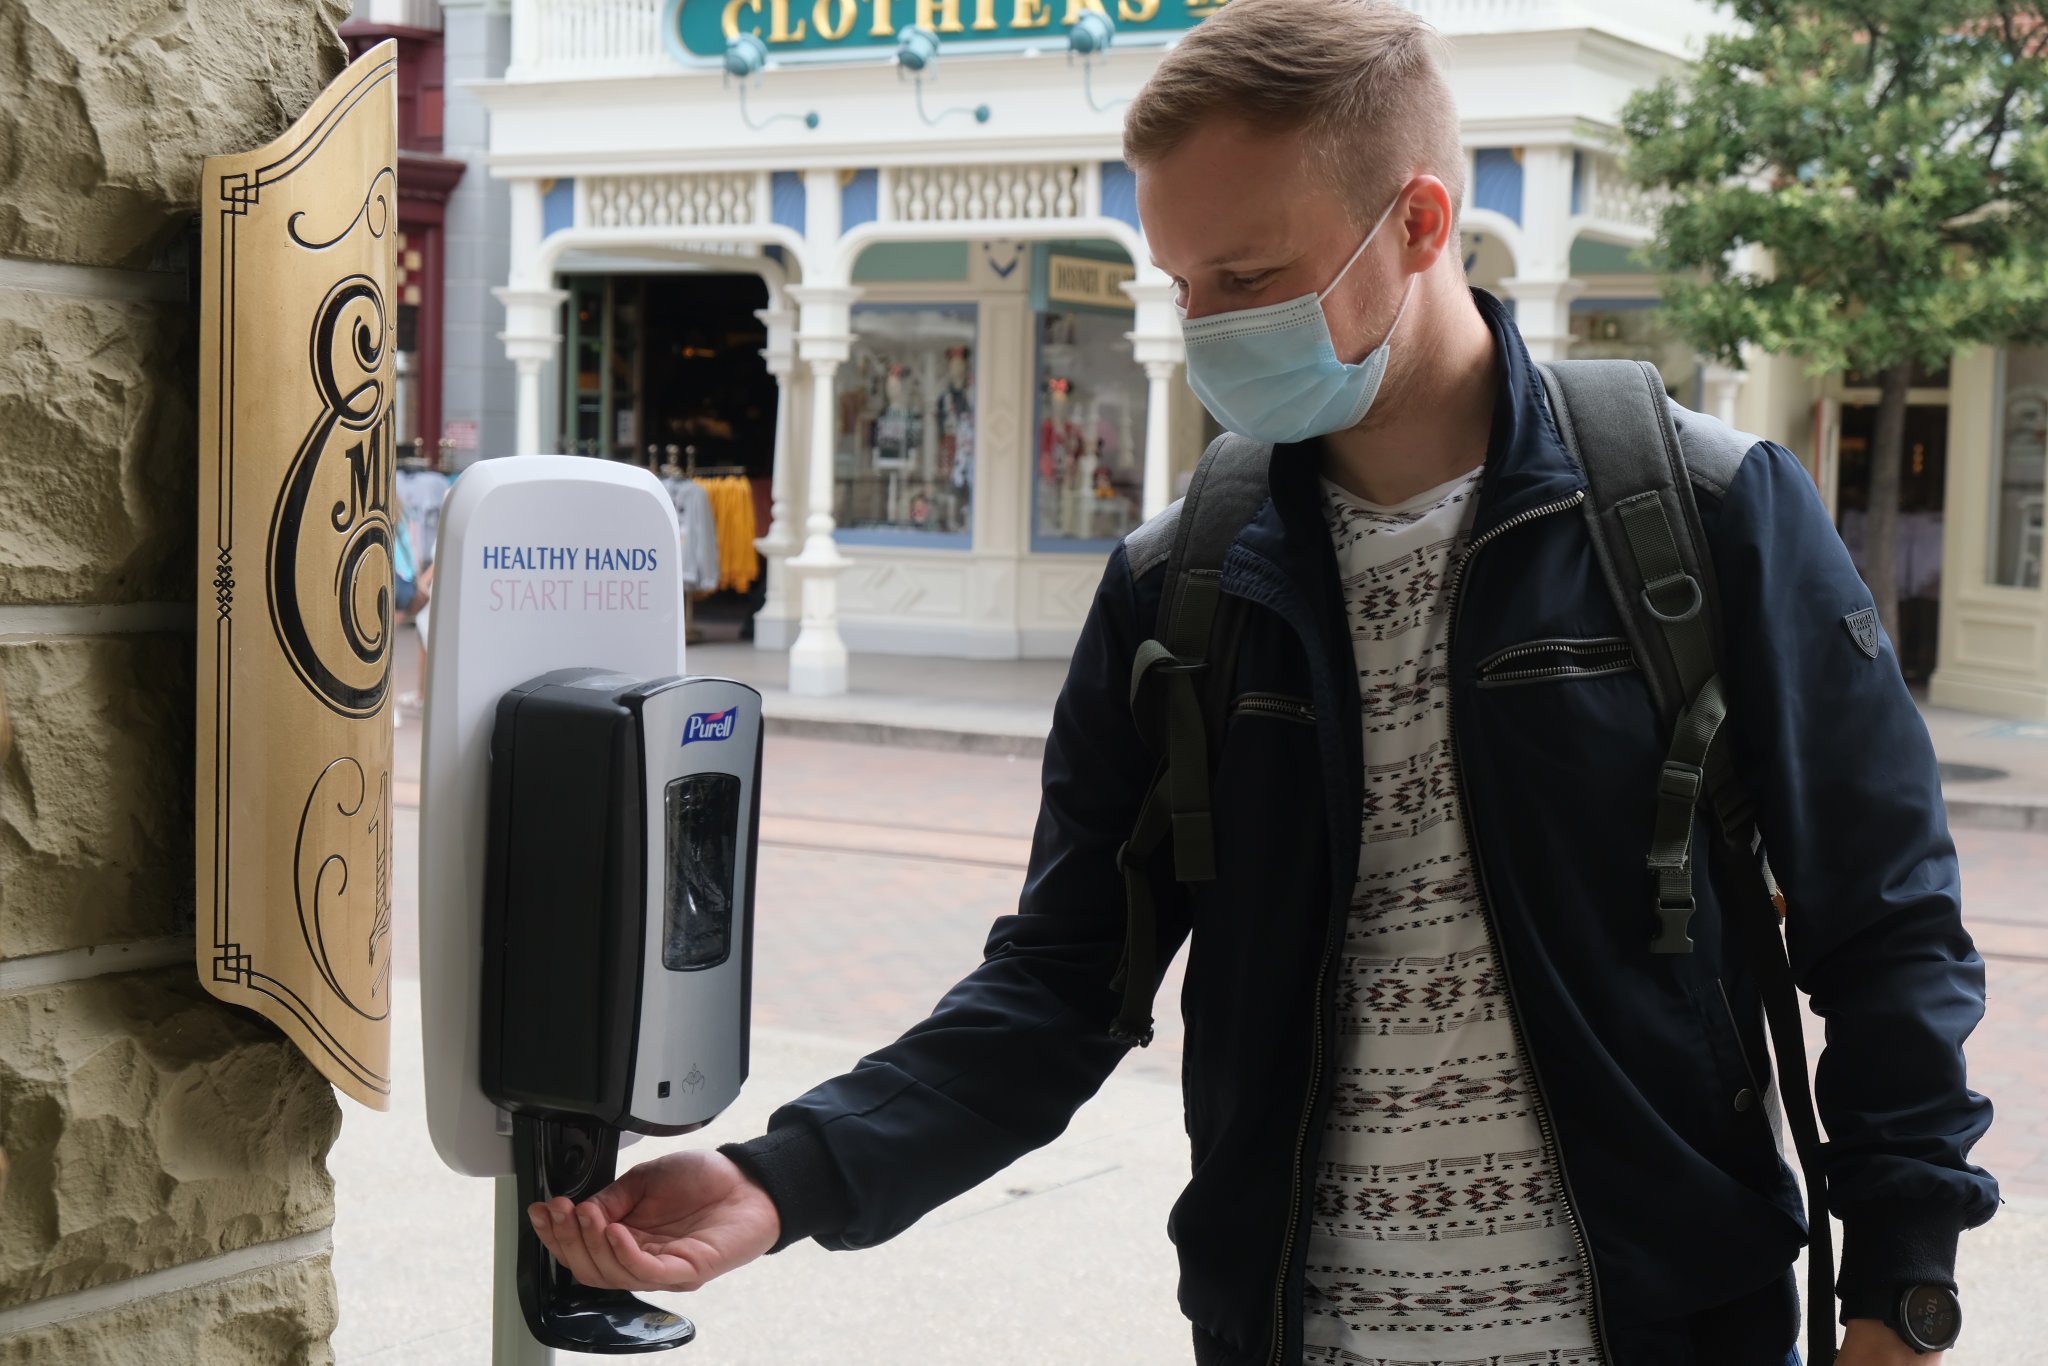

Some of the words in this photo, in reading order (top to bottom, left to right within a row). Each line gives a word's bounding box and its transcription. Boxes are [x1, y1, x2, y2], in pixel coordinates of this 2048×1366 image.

[483, 546, 578, 570] HEALTHY
[585, 548, 657, 571] HANDS
[489, 578, 573, 611] START
[583, 580, 649, 611] HERE
[689, 715, 732, 738] Purell
